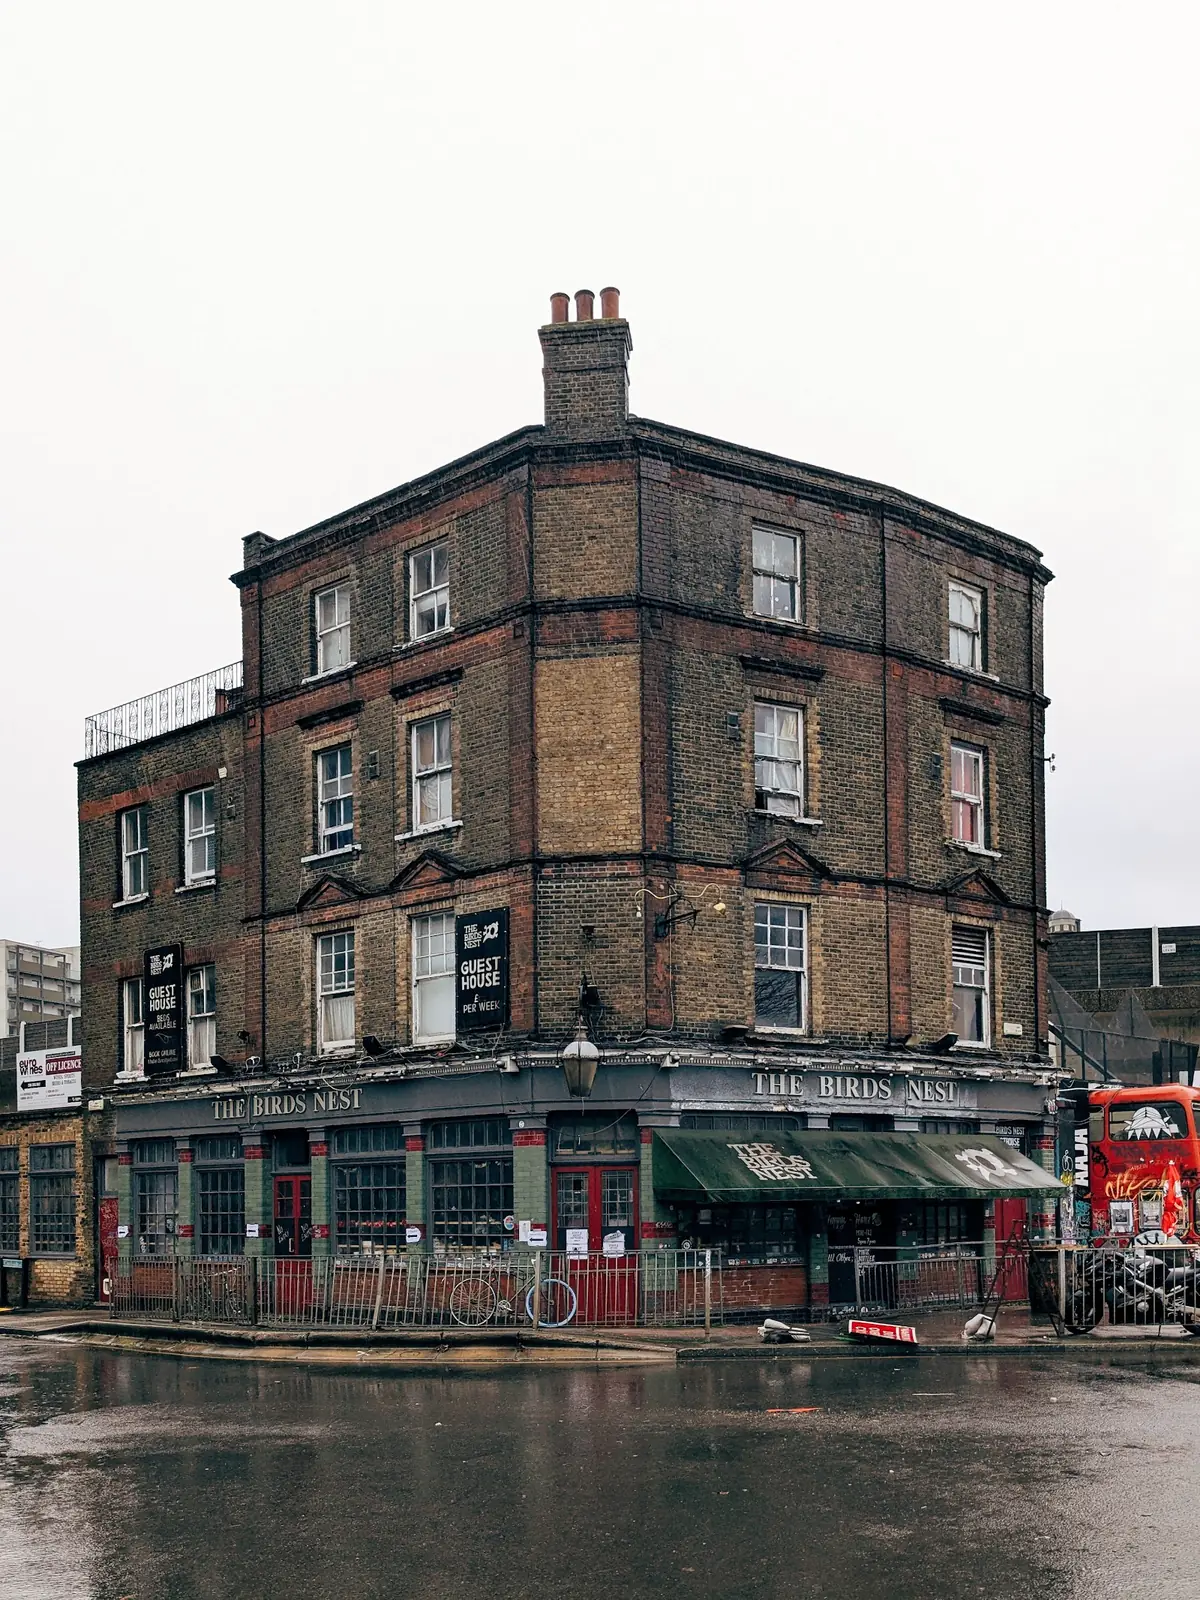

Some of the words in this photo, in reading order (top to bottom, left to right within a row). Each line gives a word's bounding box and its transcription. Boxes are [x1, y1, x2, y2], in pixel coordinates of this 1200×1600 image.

[464, 924, 478, 933] THE
[464, 931, 482, 941] BIRDS
[464, 940, 481, 949] NEST
[461, 956, 501, 975] GUEST
[461, 972, 500, 990] HOUSE
[149, 984, 176, 999] GUEST
[150, 996, 176, 1011] HOUSE
[463, 1003, 477, 1013] PER
[479, 1001, 500, 1011] WEEK
[149, 1020, 177, 1030] AVAILABLE
[46, 1062, 58, 1072] OFF
[58, 1059, 82, 1071] LICENCE
[751, 1072, 804, 1096] THE
[818, 1075, 893, 1099] BIRDS
[907, 1080, 957, 1101] NEST
[211, 1100, 245, 1119] THE
[252, 1094, 306, 1117] BIRDS
[313, 1088, 363, 1112] NEST
[726, 1143, 782, 1157] THE
[738, 1155, 811, 1169] BIRDS
[1074, 1128, 1089, 1187] AAJA
[750, 1167, 818, 1180] NEST
